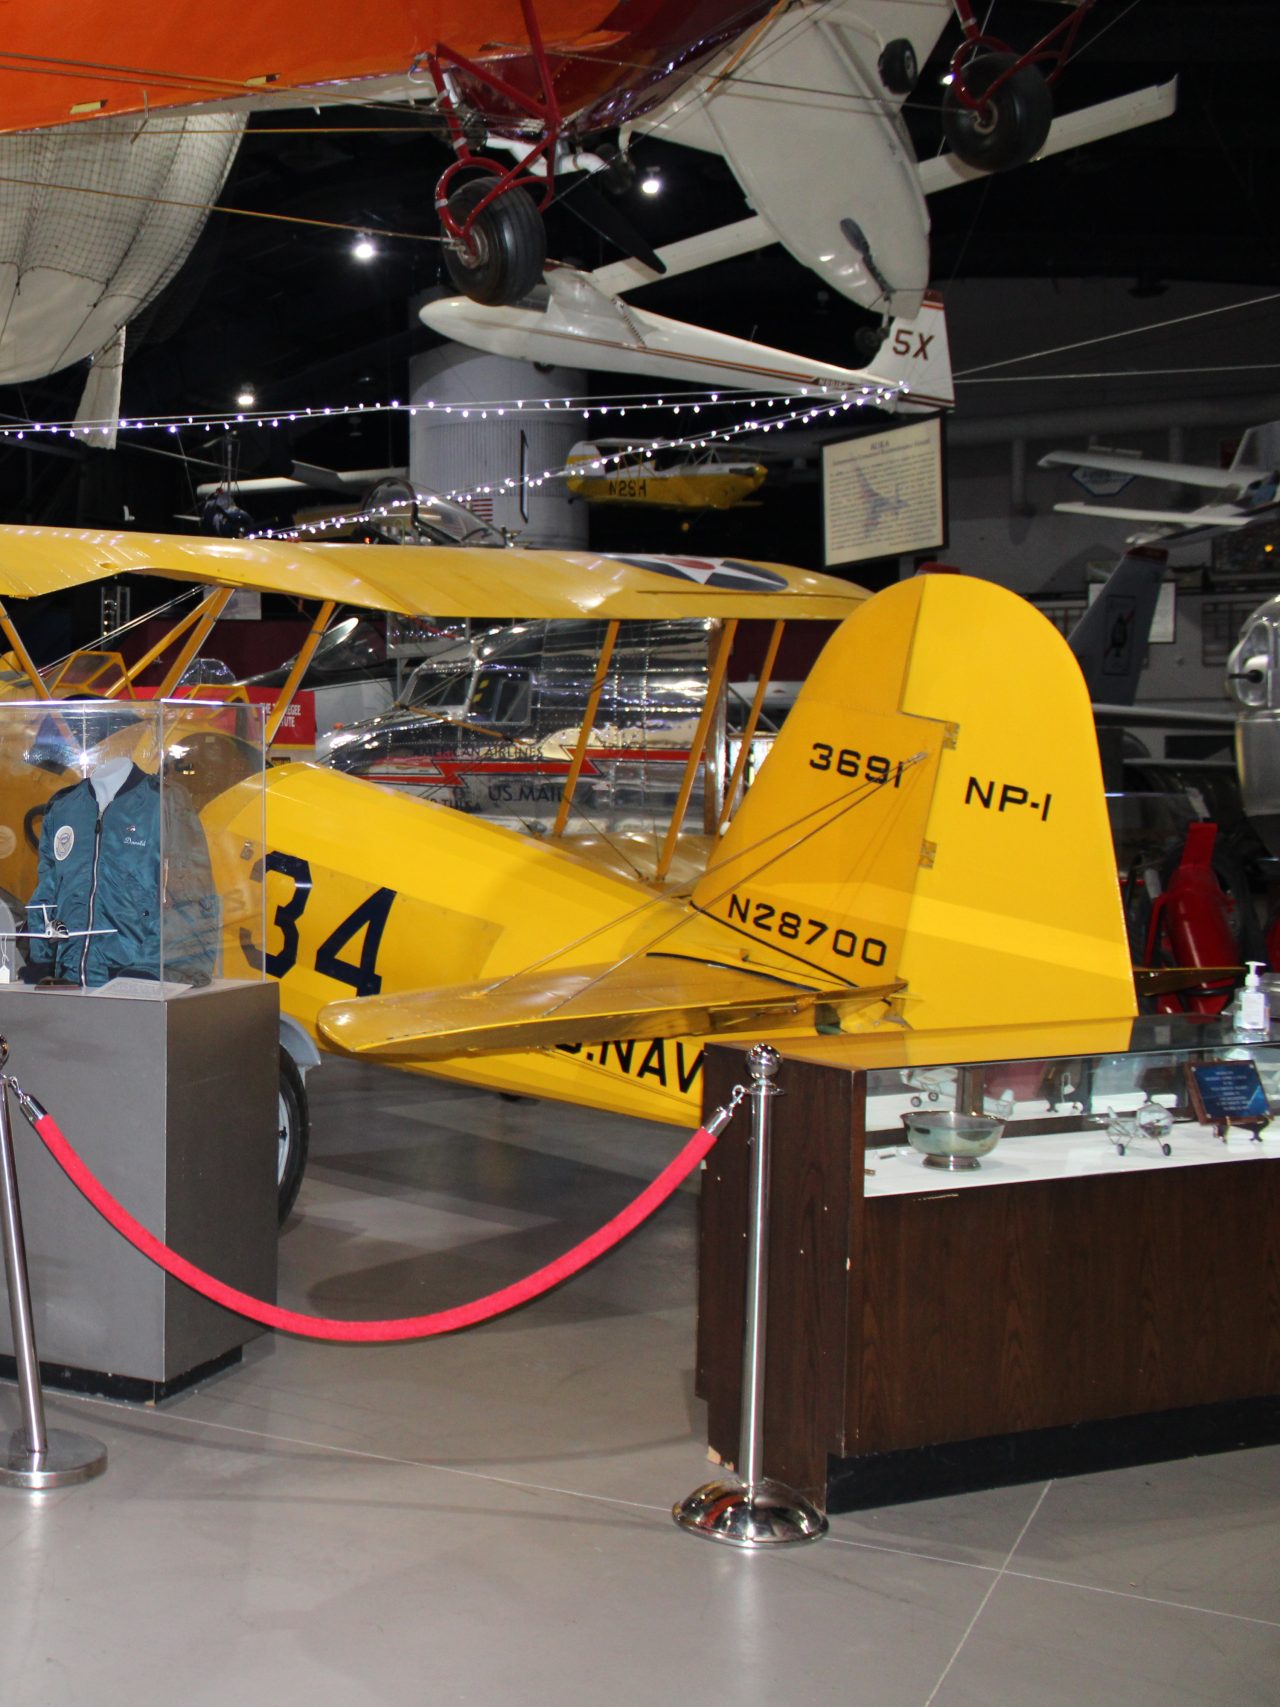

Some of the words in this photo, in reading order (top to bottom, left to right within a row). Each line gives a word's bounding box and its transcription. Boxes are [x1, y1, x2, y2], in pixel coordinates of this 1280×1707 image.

[892, 328, 934, 360] 5X
[809, 742, 903, 788] 3691
[965, 776, 1052, 822] NP-1
[239, 850, 397, 997] 34
[728, 893, 887, 967] N28700
